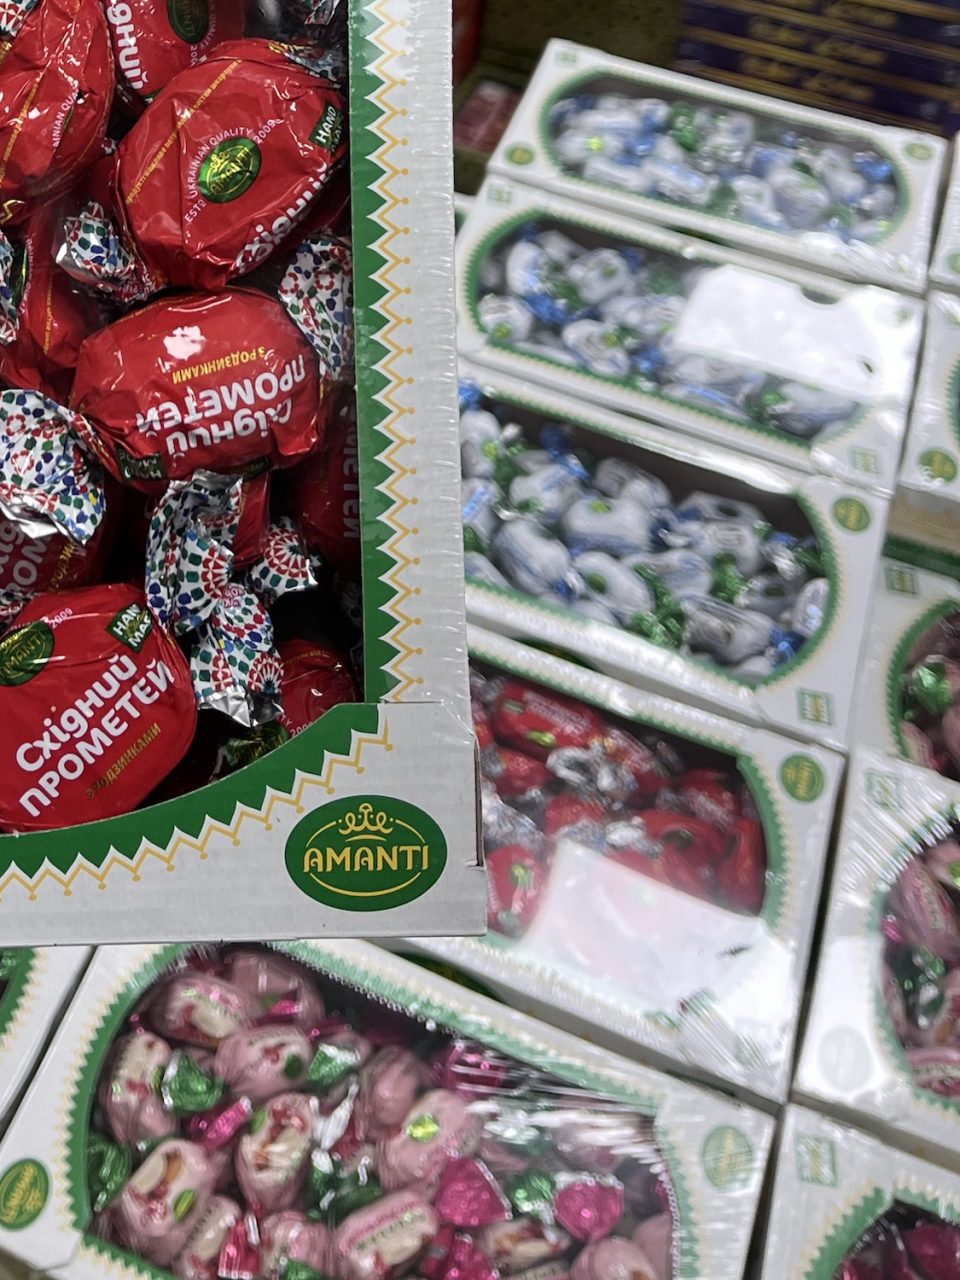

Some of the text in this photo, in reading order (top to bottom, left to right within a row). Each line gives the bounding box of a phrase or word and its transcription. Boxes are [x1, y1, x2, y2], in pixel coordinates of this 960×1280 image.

[252, 119, 277, 145] 2009
[314, 104, 338, 144] HAND
[187, 126, 254, 199] UKRAINIAN QUALITY
[210, 146, 251, 194] AMANTI
[171, 349, 257, 385] РОДЗИНКАМИ
[135, 353, 306, 438] ПРОМЕТЕЙ
[48, 607, 74, 630] 2009
[112, 603, 143, 637] HAN
[15, 652, 139, 773] Східний
[18, 658, 177, 818] ПРОМЕТЕЙ
[93, 721, 162, 794] РОДЗИНКАМИ
[302, 844, 430, 873] AMANTI
